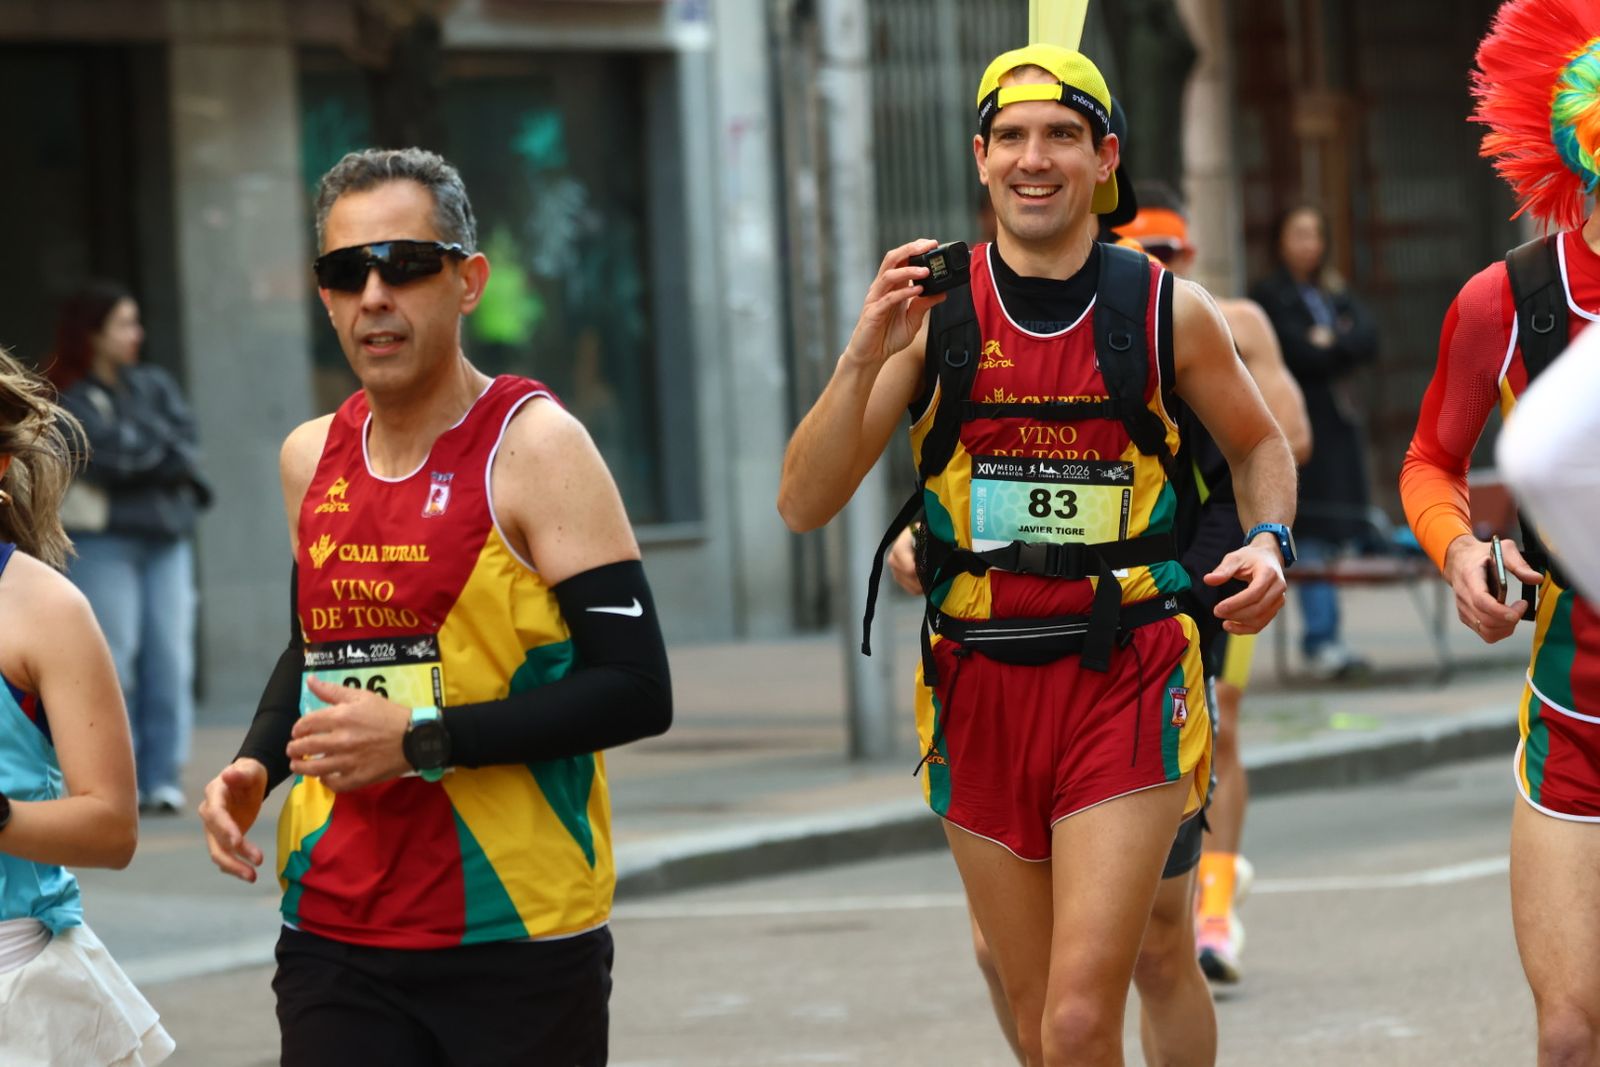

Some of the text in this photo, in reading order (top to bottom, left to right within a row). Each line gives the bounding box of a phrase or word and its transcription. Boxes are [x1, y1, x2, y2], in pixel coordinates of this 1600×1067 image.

[1018, 426, 1078, 445] VINO
[977, 463, 997, 475] XIV
[997, 464, 1023, 472] MEDIA
[1062, 464, 1090, 476] 2026
[1028, 488, 1078, 519] 83
[1018, 525, 1086, 536] JAVIER TIGRE
[338, 544, 430, 563] CAJA RURAL
[331, 579, 395, 602] VINO
[311, 606, 419, 630] DE TORO
[369, 643, 396, 658] 2026
